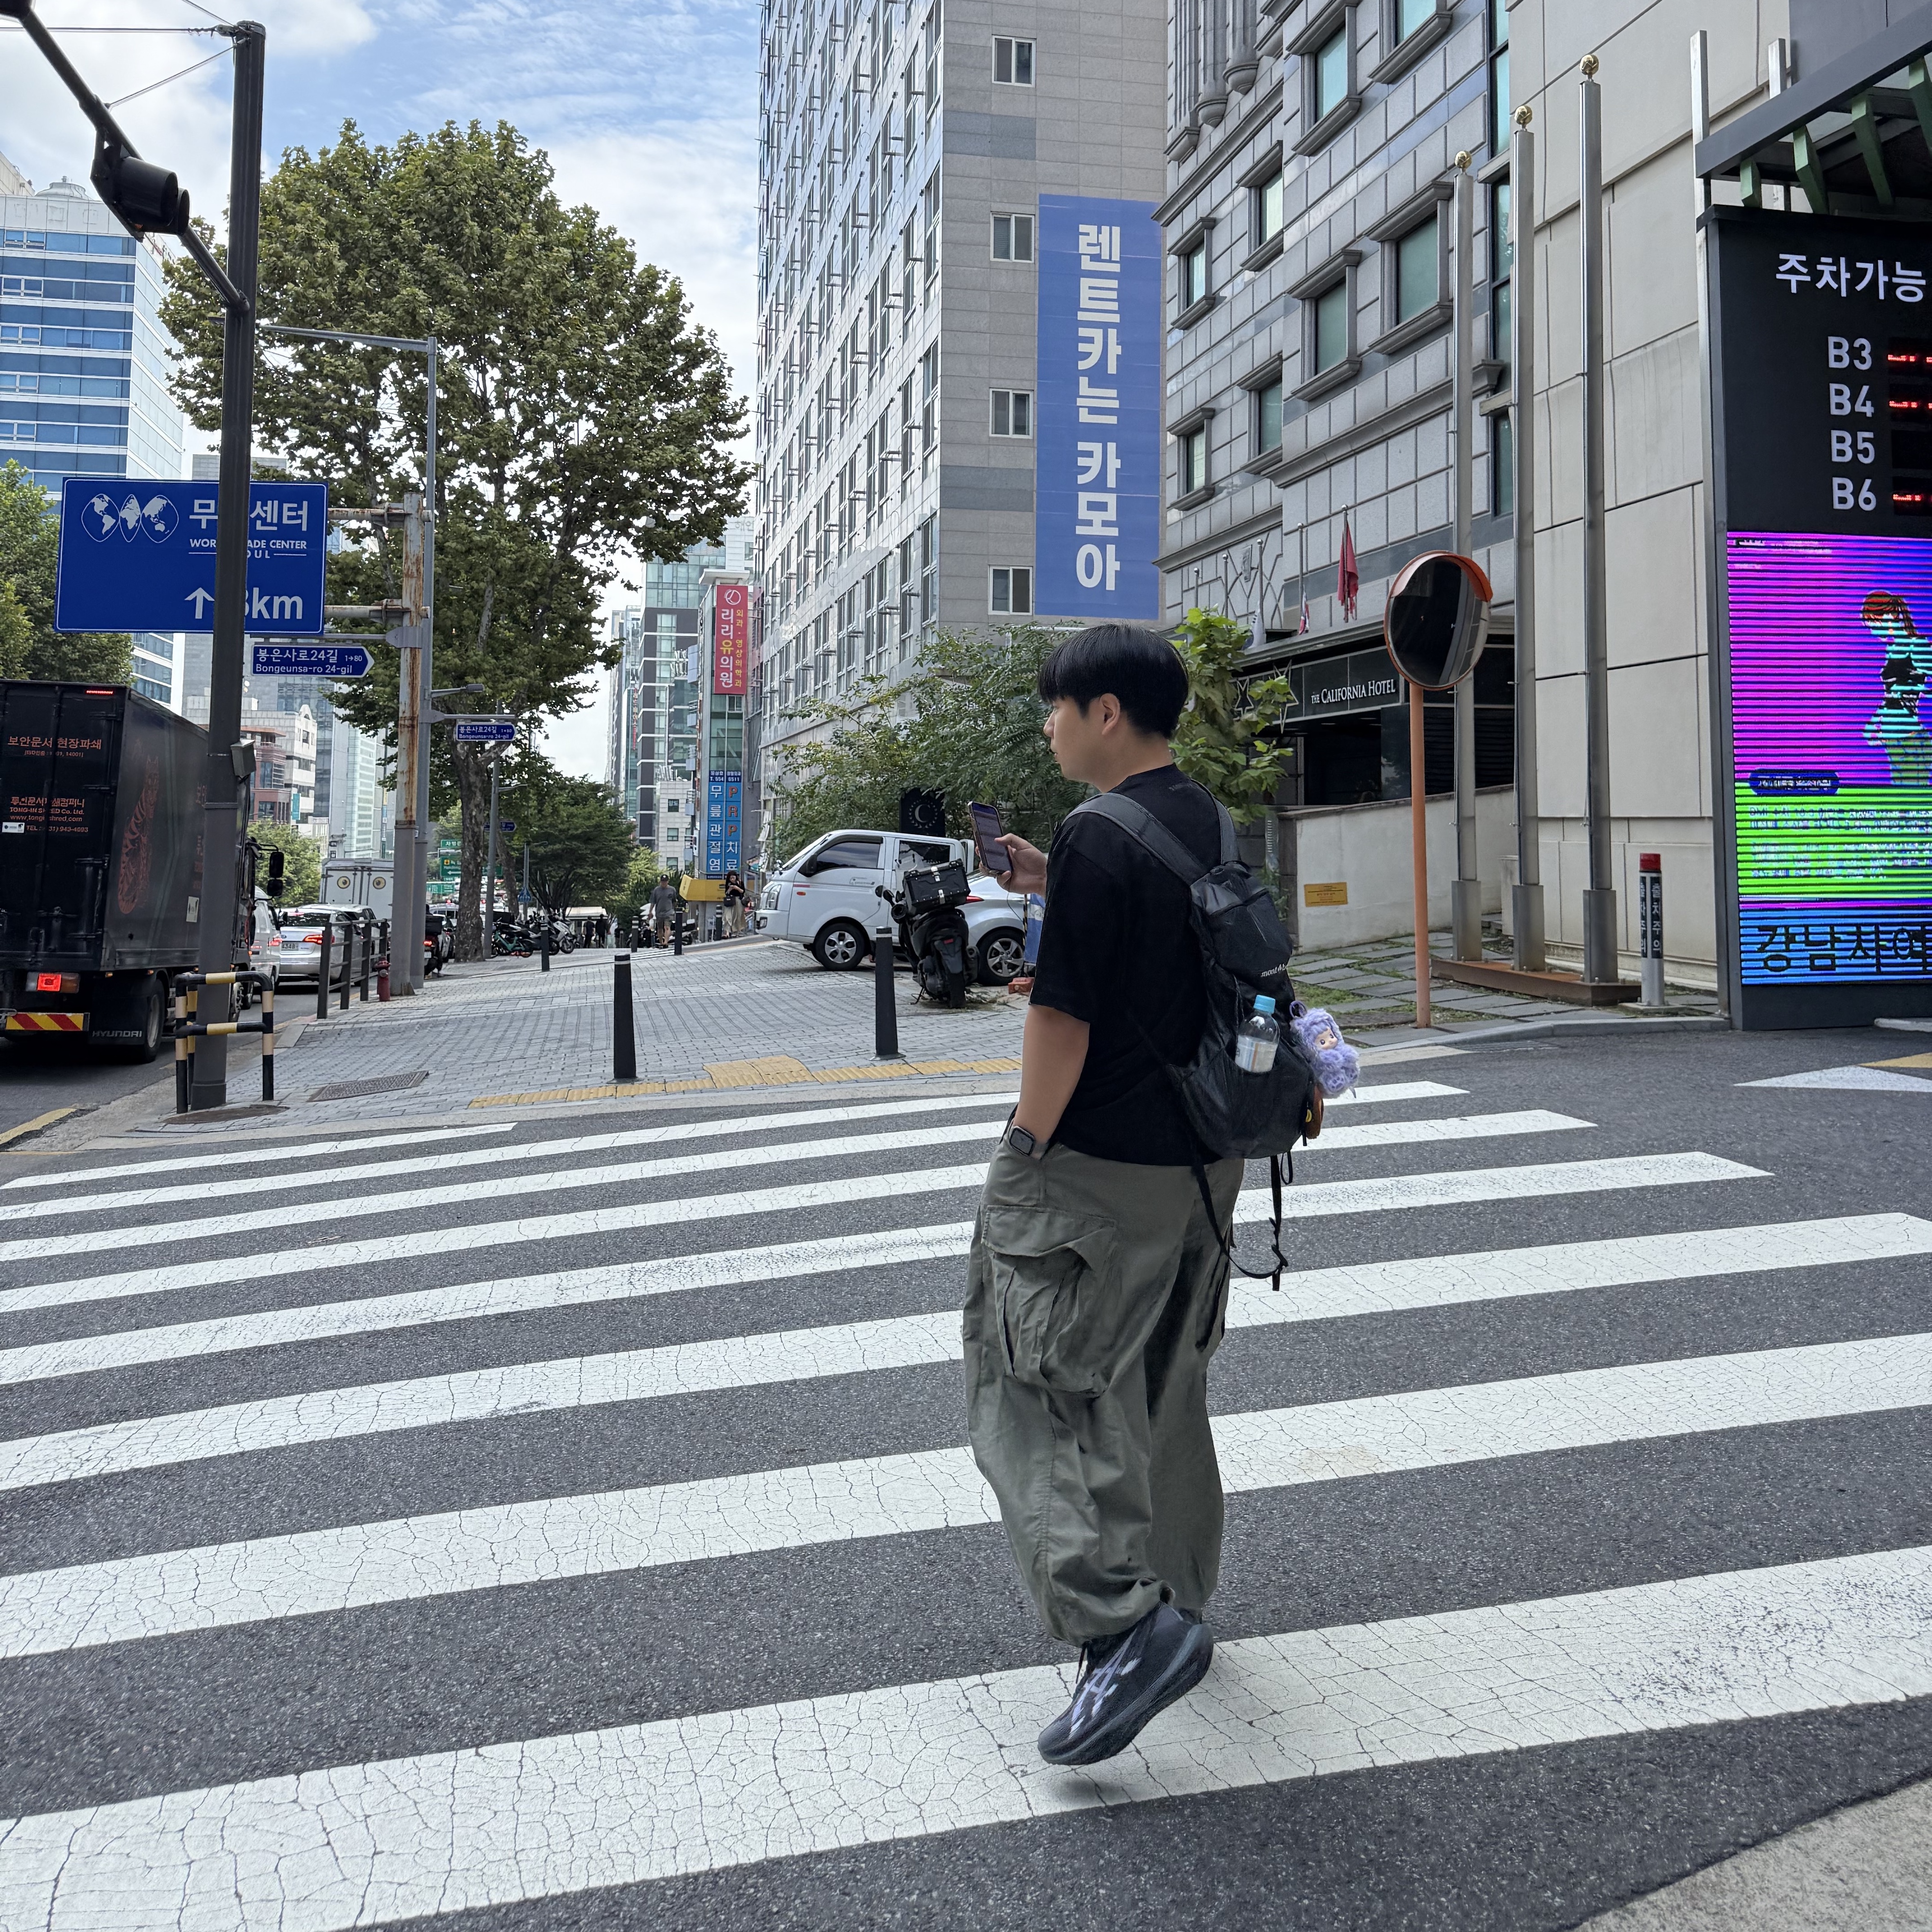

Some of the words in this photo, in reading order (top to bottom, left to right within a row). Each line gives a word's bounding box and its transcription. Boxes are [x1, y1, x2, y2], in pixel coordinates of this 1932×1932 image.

[1776, 253, 1926, 303] 주차가능
[1076, 224, 1122, 425] 렌트카는
[1827, 336, 1872, 371] B3
[1829, 383, 1875, 418] B4
[1831, 429, 1875, 464] B5
[1832, 477, 1877, 512] B6
[189, 499, 308, 531] 무센터
[1075, 442, 1121, 591] 카모아
[189, 538, 216, 548] WOR
[247, 539, 266, 548] ADE
[269, 540, 307, 549] CENTER
[256, 648, 338, 663] 봉은사로24길
[256, 664, 323, 673] Bongeunsa-ro
[325, 665, 353, 675] 24-gil
[1311, 694, 1320, 704] THE
[1321, 684, 1367, 704] CALIFORNIA
[1368, 679, 1396, 697] HOTEL
[7, 736, 53, 748] 보안문서
[57, 738, 102, 750] 현장파쇄
